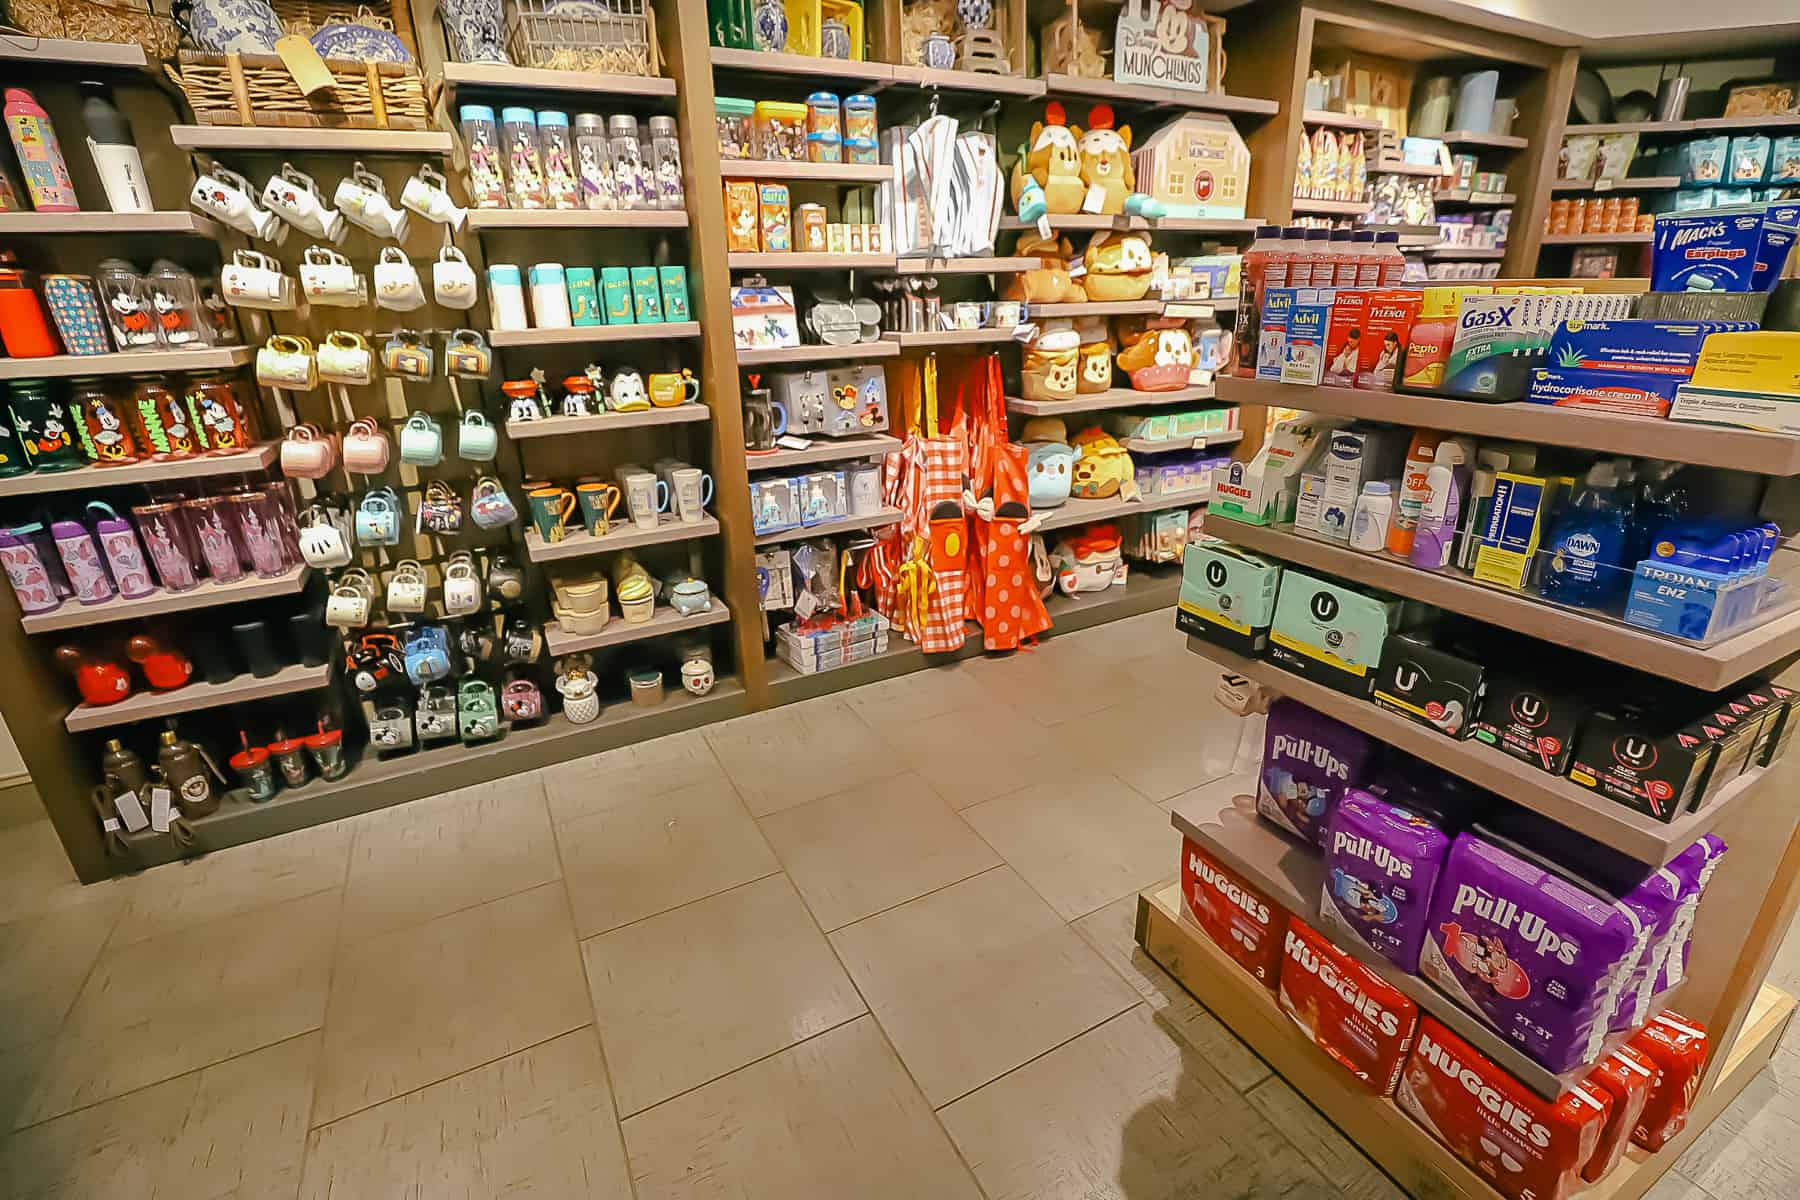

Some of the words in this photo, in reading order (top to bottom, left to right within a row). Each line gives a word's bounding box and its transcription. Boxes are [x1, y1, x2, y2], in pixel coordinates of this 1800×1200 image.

[1122, 50, 1202, 84] MUNCHLINGS
[1685, 248, 1746, 260] Earplugs
[1266, 297, 1291, 309] Advil
[1335, 296, 1363, 305] TYLENOL
[1292, 313, 1319, 325] Advil
[1369, 307, 1406, 319] TYLENOL
[1462, 306, 1516, 328] Gas-X
[1409, 342, 1439, 354] Pepto
[1466, 344, 1491, 359] EXTRA
[1532, 381, 1606, 398] hydrocortisone
[1607, 390, 1642, 400] cream
[1644, 391, 1661, 402] 1%
[1216, 482, 1252, 499] HUGGIES
[1567, 537, 1600, 553] DAWN
[1210, 565, 1223, 582] U
[1643, 566, 1713, 589] TROJAN
[1657, 585, 1688, 600] ENZ
[1316, 599, 1332, 616] U
[1394, 665, 1418, 691] U
[1522, 696, 1541, 716] U
[1625, 737, 1647, 759] U
[1188, 851, 1271, 925] HUGGIES
[1256, 966, 1265, 978] 3
[1284, 930, 1399, 1037] HUGGIES
[1514, 1012, 1553, 1040] 2T-3T
[1511, 1028, 1526, 1042] 23
[1617, 1065, 1632, 1076] 5
[1418, 1034, 1552, 1149] HUGGIES
[1569, 1097, 1583, 1108] 5
[1476, 1105, 1501, 1129] little
[1502, 1127, 1544, 1160] movers
